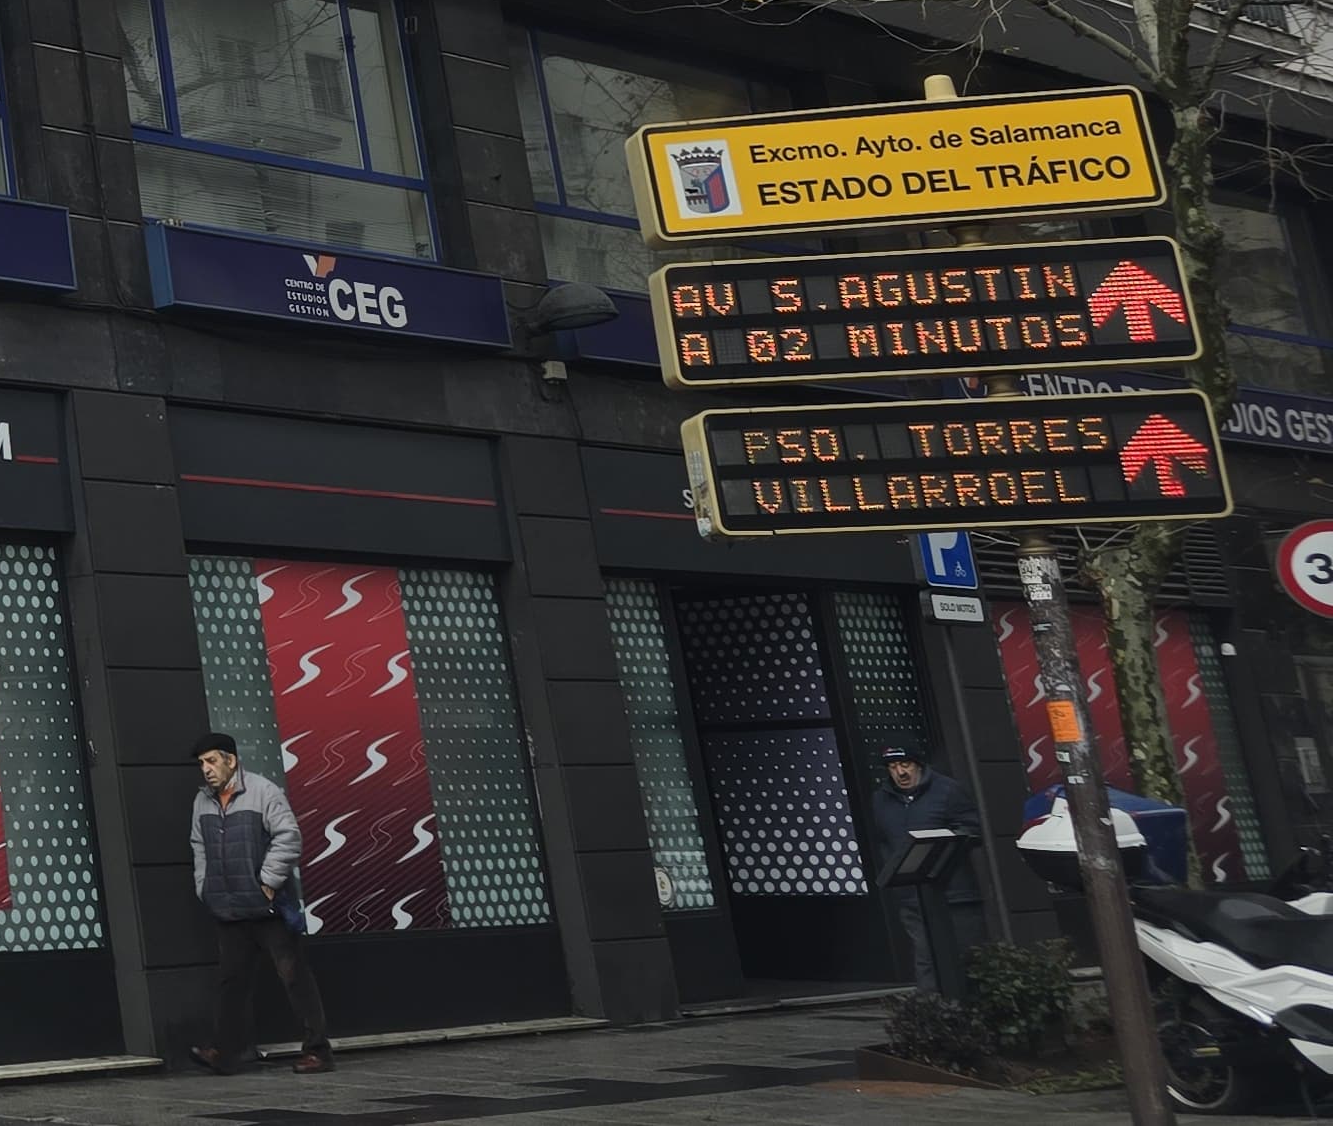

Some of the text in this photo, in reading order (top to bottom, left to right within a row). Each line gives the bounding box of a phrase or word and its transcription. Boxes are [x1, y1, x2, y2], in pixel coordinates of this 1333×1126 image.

[749, 115, 1121, 165] Excmo. Ayto. de Salamanca
[758, 154, 1131, 207] ESTADO DEL TRÁFICO
[284, 278, 326, 292] CENTRO DE
[286, 290, 328, 305] ESTUDIOS
[328, 278, 408, 328] CEG
[672, 279, 734, 317] AV
[679, 314, 1089, 367] A 02 MINUTOS
[908, 417, 1108, 459] TORRES
[1284, 408, 1333, 445] GES
[751, 468, 1088, 514] VILLARROEL
